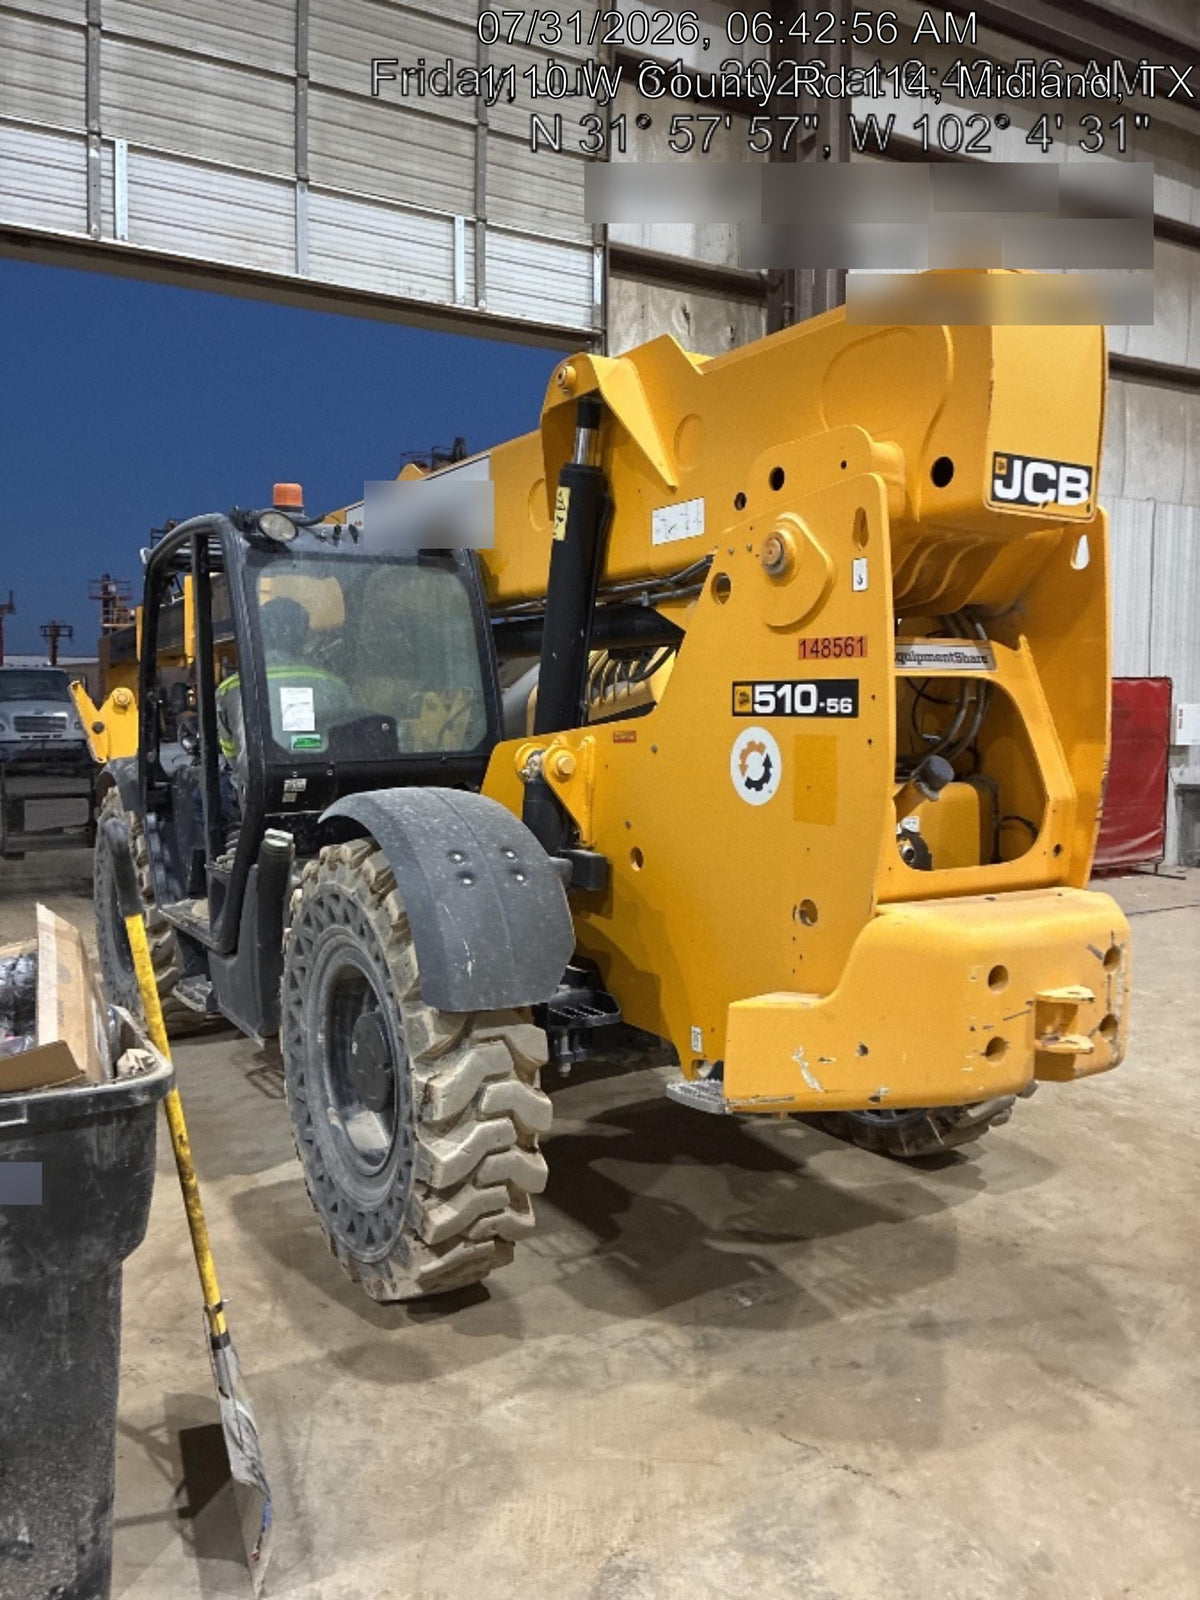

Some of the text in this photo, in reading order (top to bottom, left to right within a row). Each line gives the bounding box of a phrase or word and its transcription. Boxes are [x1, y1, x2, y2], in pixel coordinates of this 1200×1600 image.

[994, 459, 1089, 506] JCB
[800, 636, 865, 659] 148561
[895, 650, 989, 665] quipmentShare
